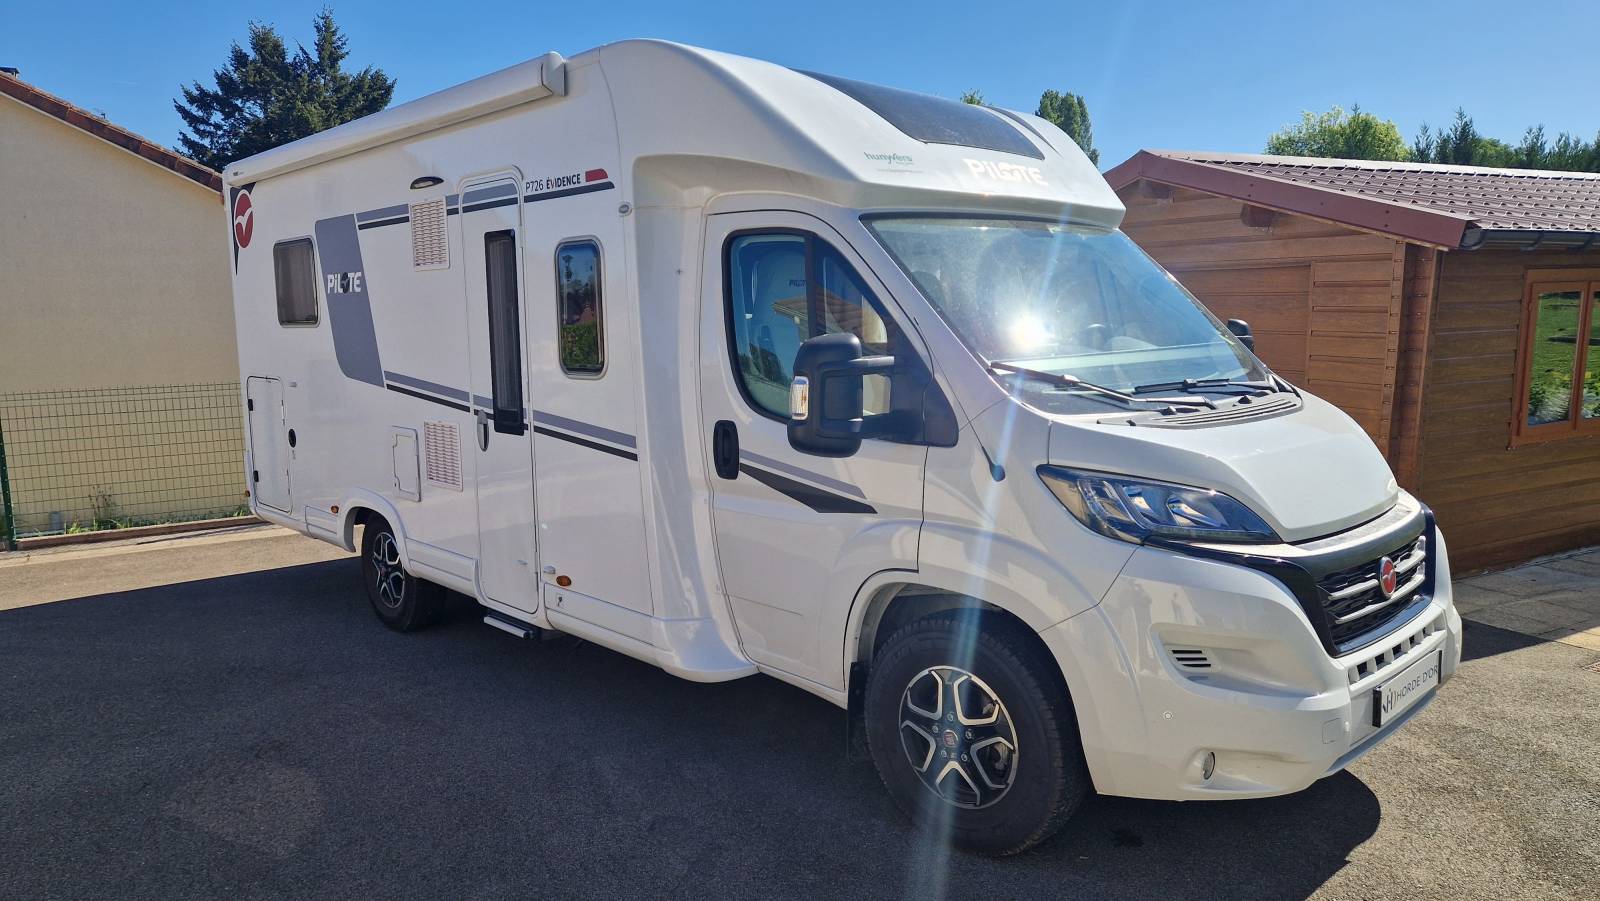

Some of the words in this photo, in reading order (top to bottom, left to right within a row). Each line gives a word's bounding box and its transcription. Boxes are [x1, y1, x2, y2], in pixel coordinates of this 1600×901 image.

[525, 180, 544, 192] P726
[546, 173, 581, 189] ÉVIDENCE
[1397, 675, 1420, 702] HORDE
[1422, 664, 1438, 683] D'OR
